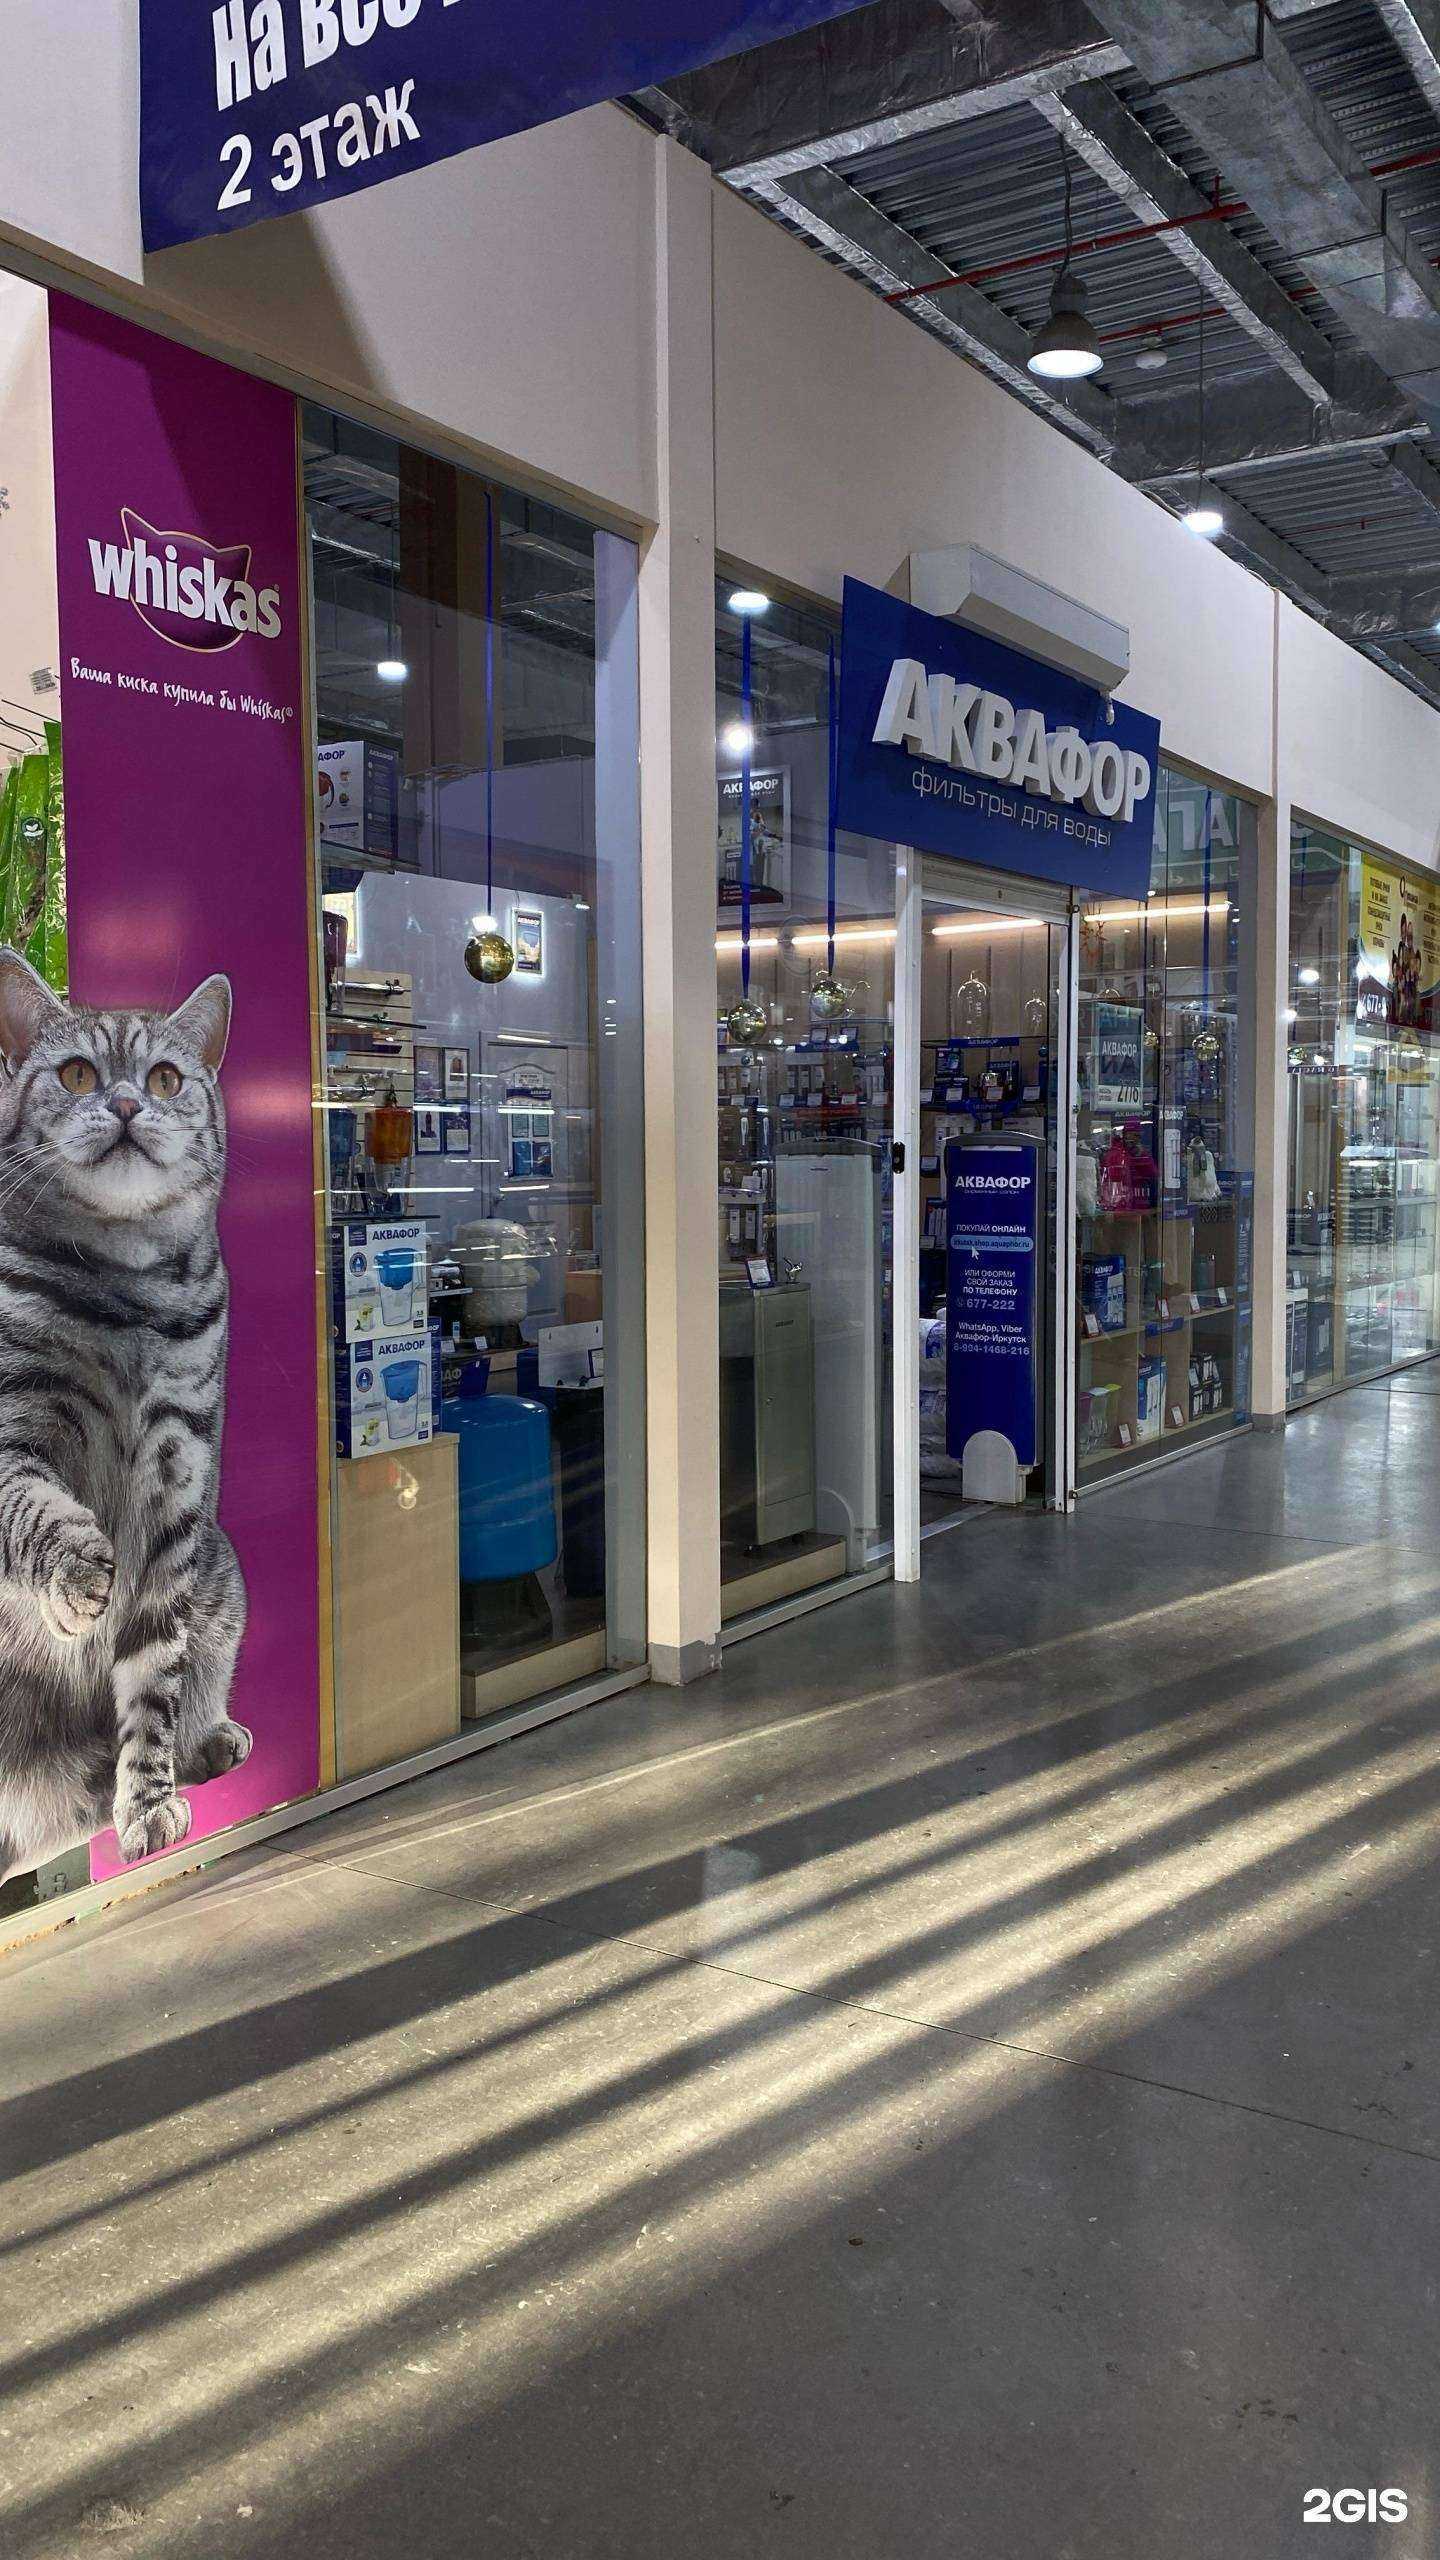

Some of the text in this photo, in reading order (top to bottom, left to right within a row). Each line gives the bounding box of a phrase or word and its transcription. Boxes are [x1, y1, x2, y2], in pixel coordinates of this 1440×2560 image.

[212, 0, 287, 111] На
[217, 78, 421, 211] 2 этаж
[70, 656, 112, 685] Ваша
[117, 673, 158, 695] киска
[163, 682, 214, 707] купила
[219, 690, 236, 711] бы
[872, 658, 1151, 822] АКВАФОР
[912, 766, 1111, 848] фильтры для воды
[1102, 1040, 1137, 1058] АКВАФОР
[955, 1176, 1031, 1189] АКВАФОР
[372, 1228, 420, 1241] АКВАФОР
[956, 1224, 1026, 1233] ПОКУПАЙ ОНЛАЙН
[989, 1279, 1013, 1287] ЗАКАЗ
[963, 1286, 1018, 1296] ПО ТЕЛЕФОНУ
[966, 1298, 1016, 1310] 677-222
[1001, 1325, 1024, 1333] Viber
[378, 1340, 425, 1356] АКВАФОР
